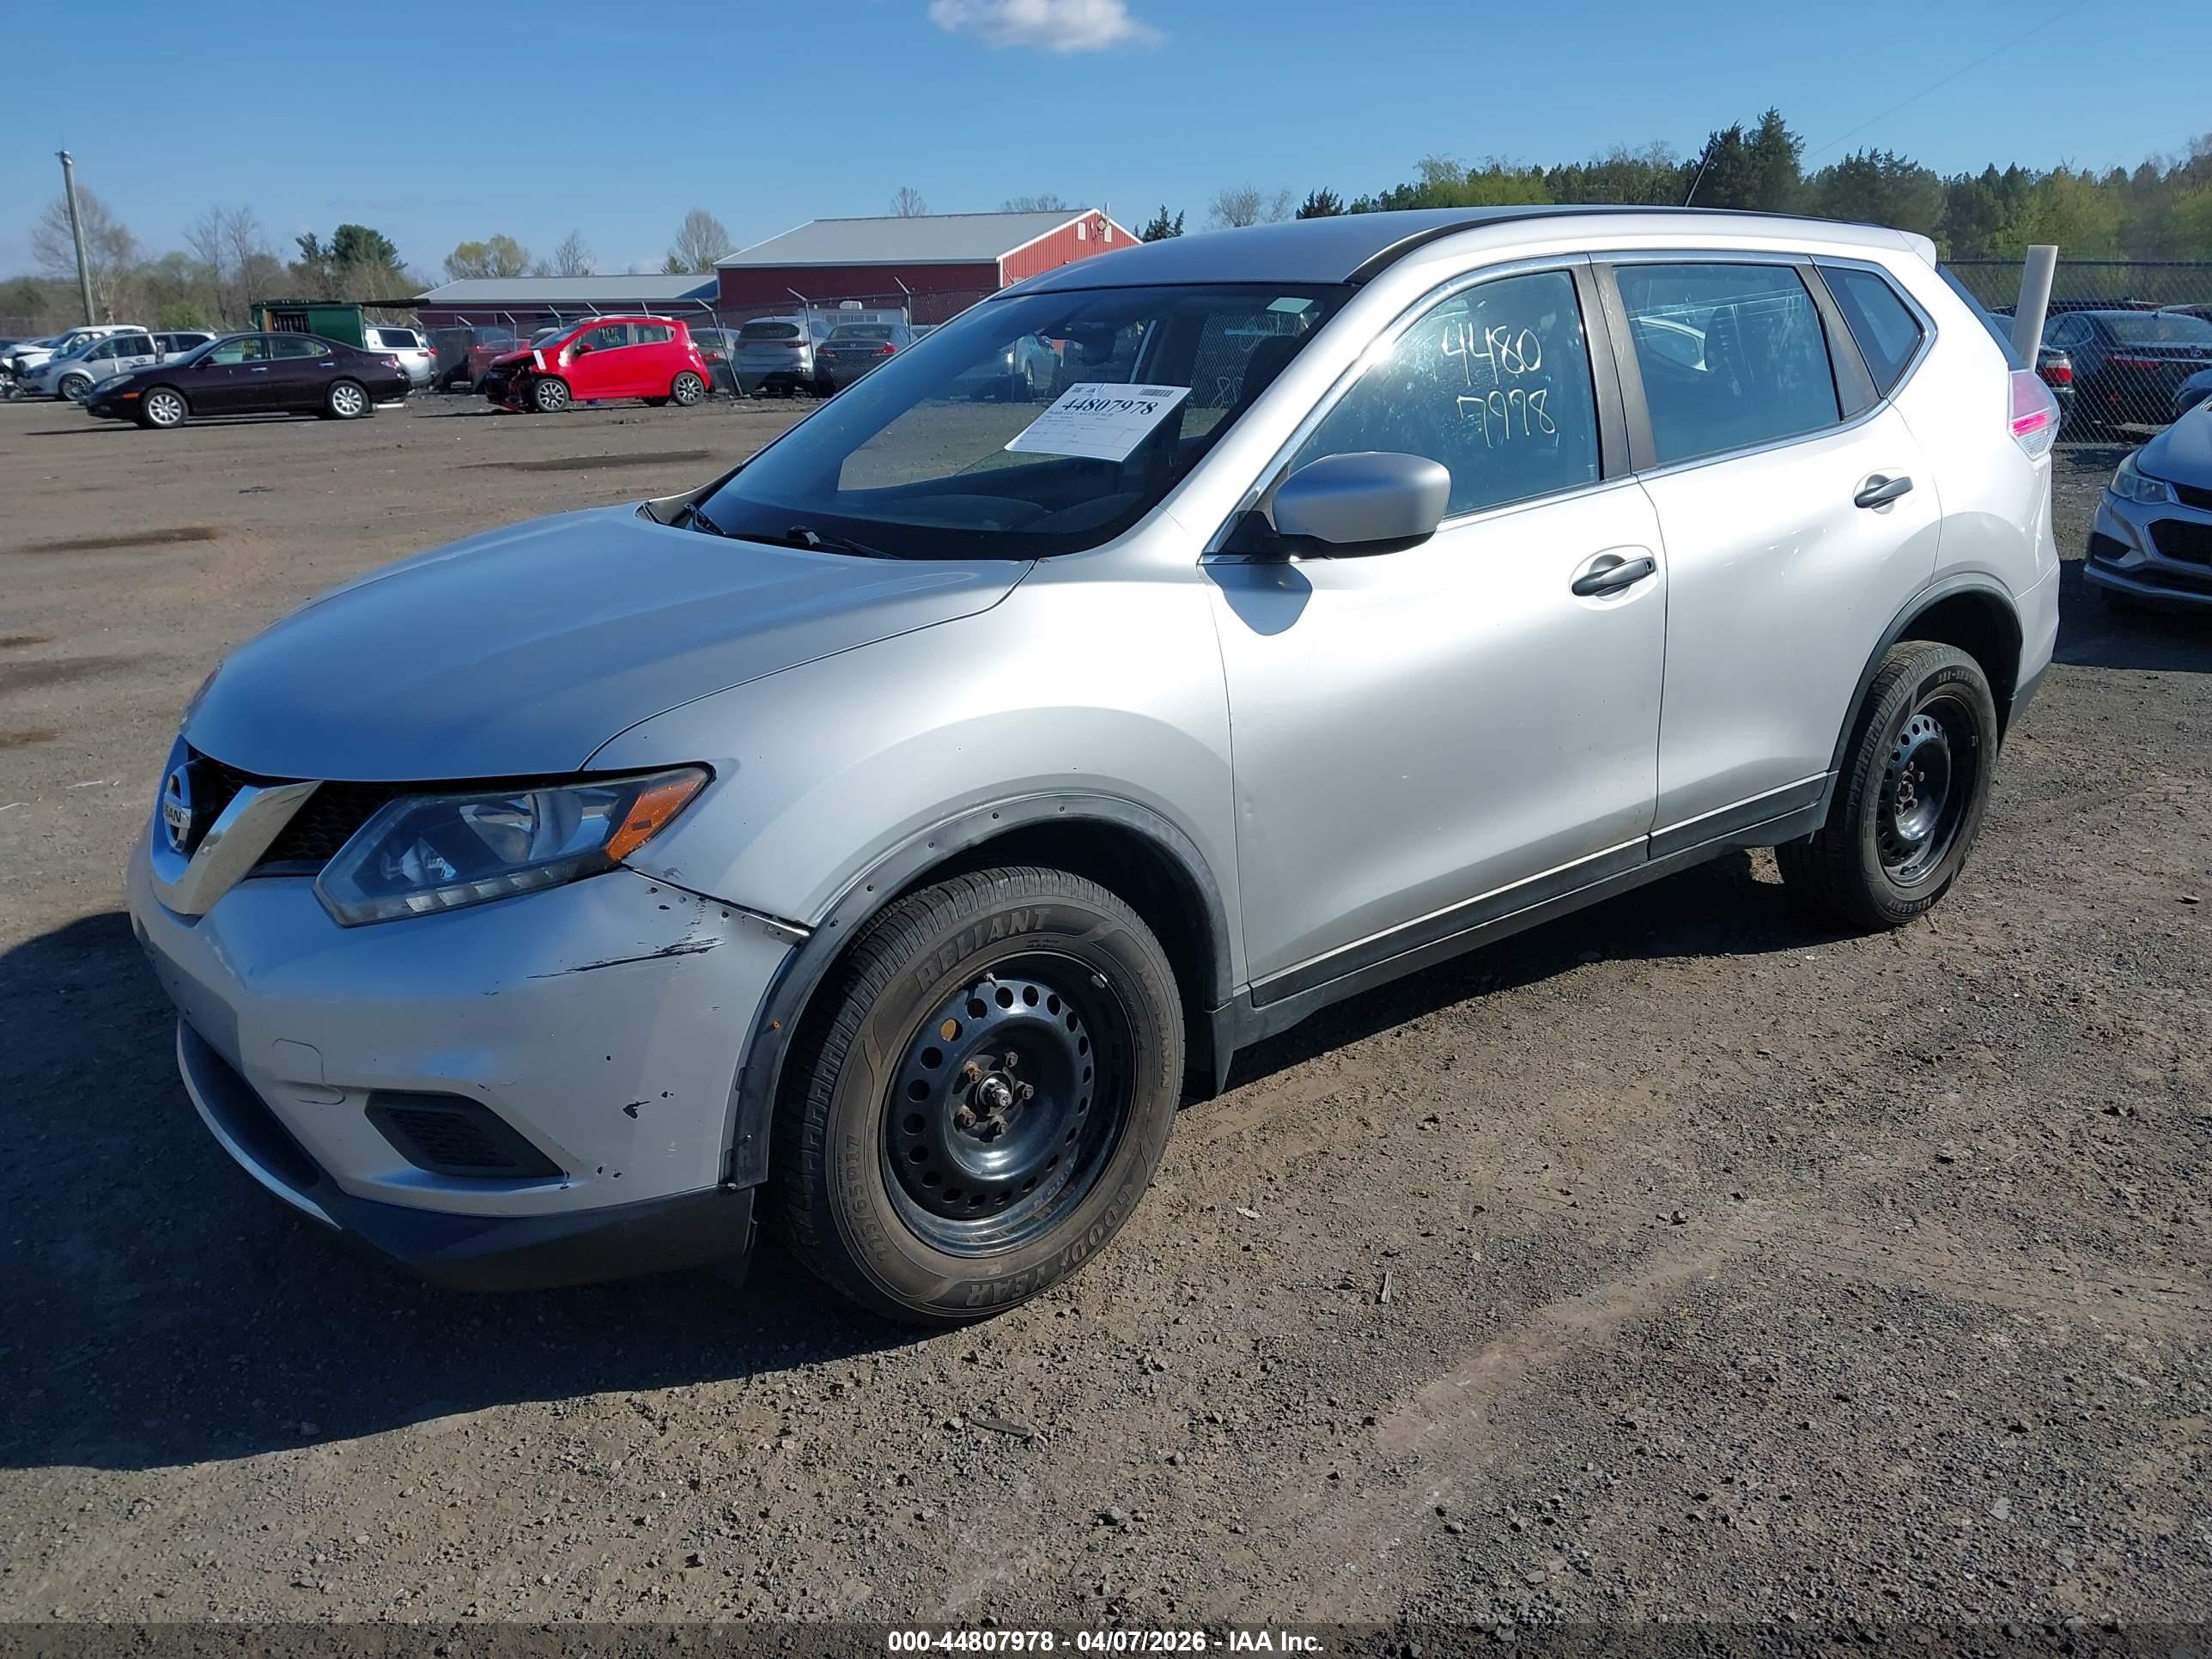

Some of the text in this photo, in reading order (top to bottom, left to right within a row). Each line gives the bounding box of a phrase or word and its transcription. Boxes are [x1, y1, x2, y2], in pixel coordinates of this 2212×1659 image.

[1442, 322, 1542, 386] 4480
[1061, 398, 1158, 416] 44807978
[1456, 387, 1556, 448] 7978
[915, 908, 1053, 993] RELIANT
